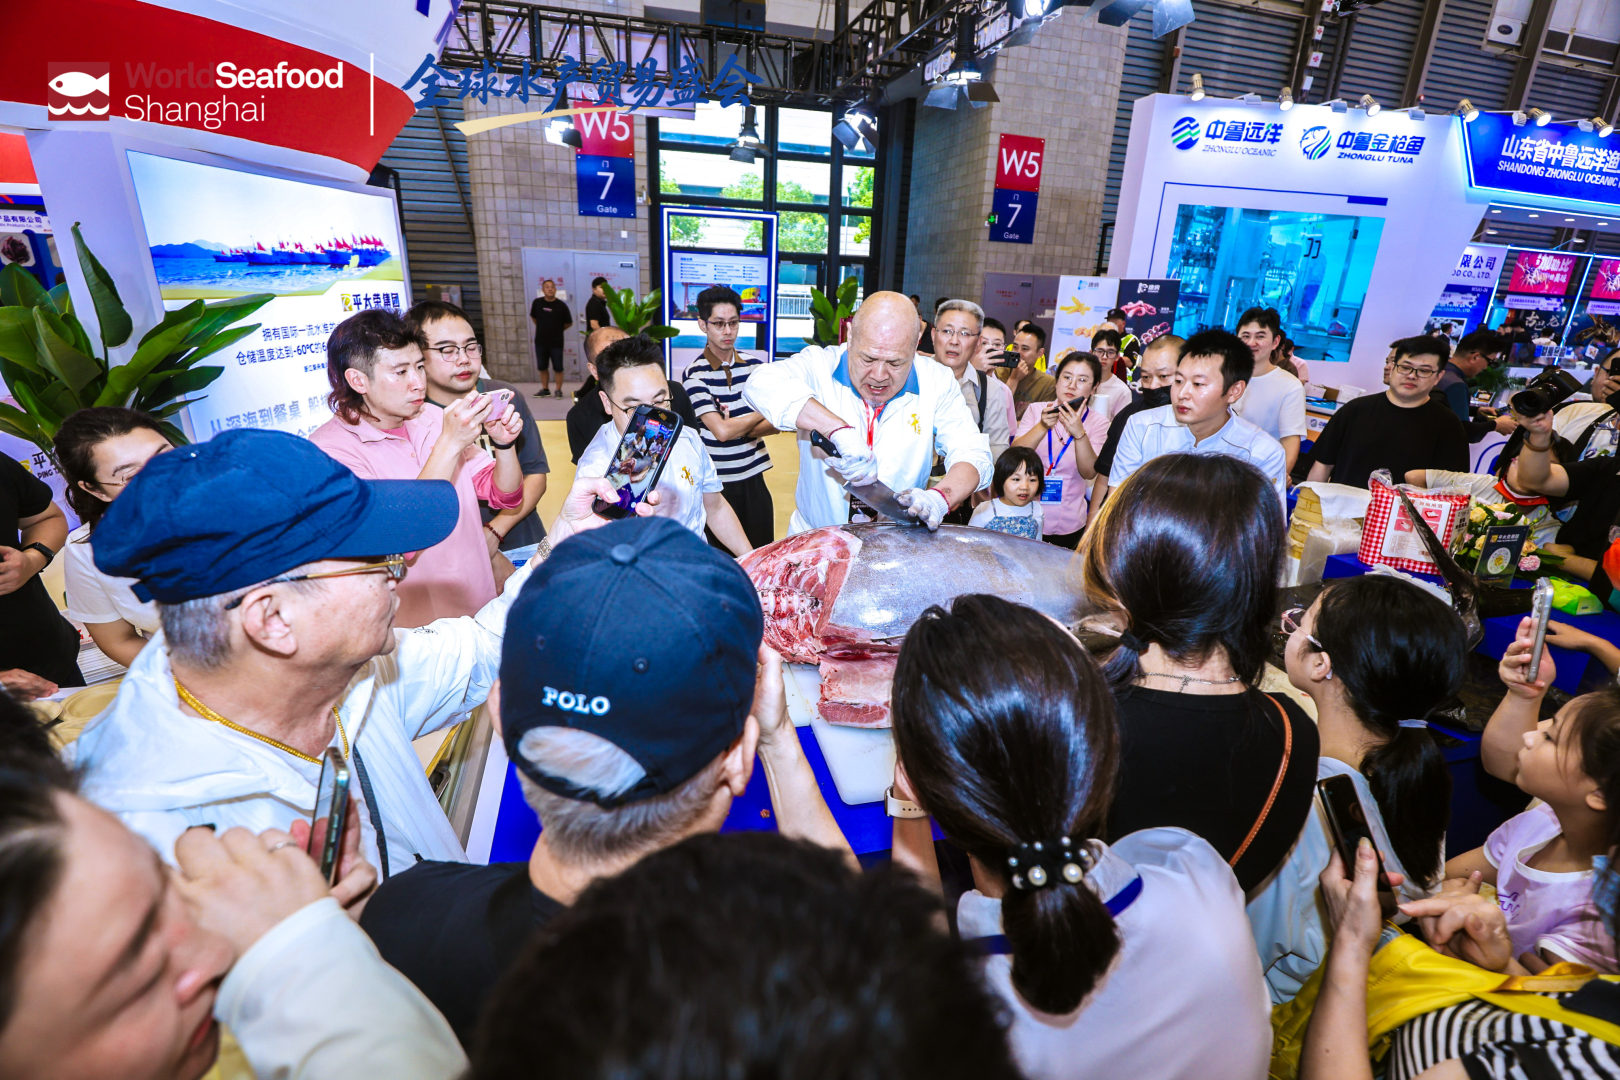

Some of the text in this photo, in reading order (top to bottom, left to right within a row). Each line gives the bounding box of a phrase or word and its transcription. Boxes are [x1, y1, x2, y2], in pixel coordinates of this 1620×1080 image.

[579, 111, 631, 142] W5
[1205, 119, 1283, 144] 中鲁远洋
[1202, 145, 1277, 157] ZHONGLU OCEANIC
[1336, 131, 1426, 155] 中鲁金枪鱼
[1001, 148, 1041, 178] W5
[1337, 152, 1414, 164] ZHONGLU TUNA
[1497, 160, 1545, 177] SHANDONG
[1545, 167, 1585, 182] ZHONGLU
[1584, 173, 1619, 187] OCEANIC
[597, 172, 615, 200] 7
[0, 215, 42, 224] 品有限公司
[596, 204, 618, 215] Gate
[1008, 204, 1022, 228] 7
[1003, 231, 1020, 240] Gate
[352, 292, 401, 311] 平太荣集团
[236, 341, 329, 365] 仓储温度达到-60℃的6
[542, 686, 611, 716] POLO
